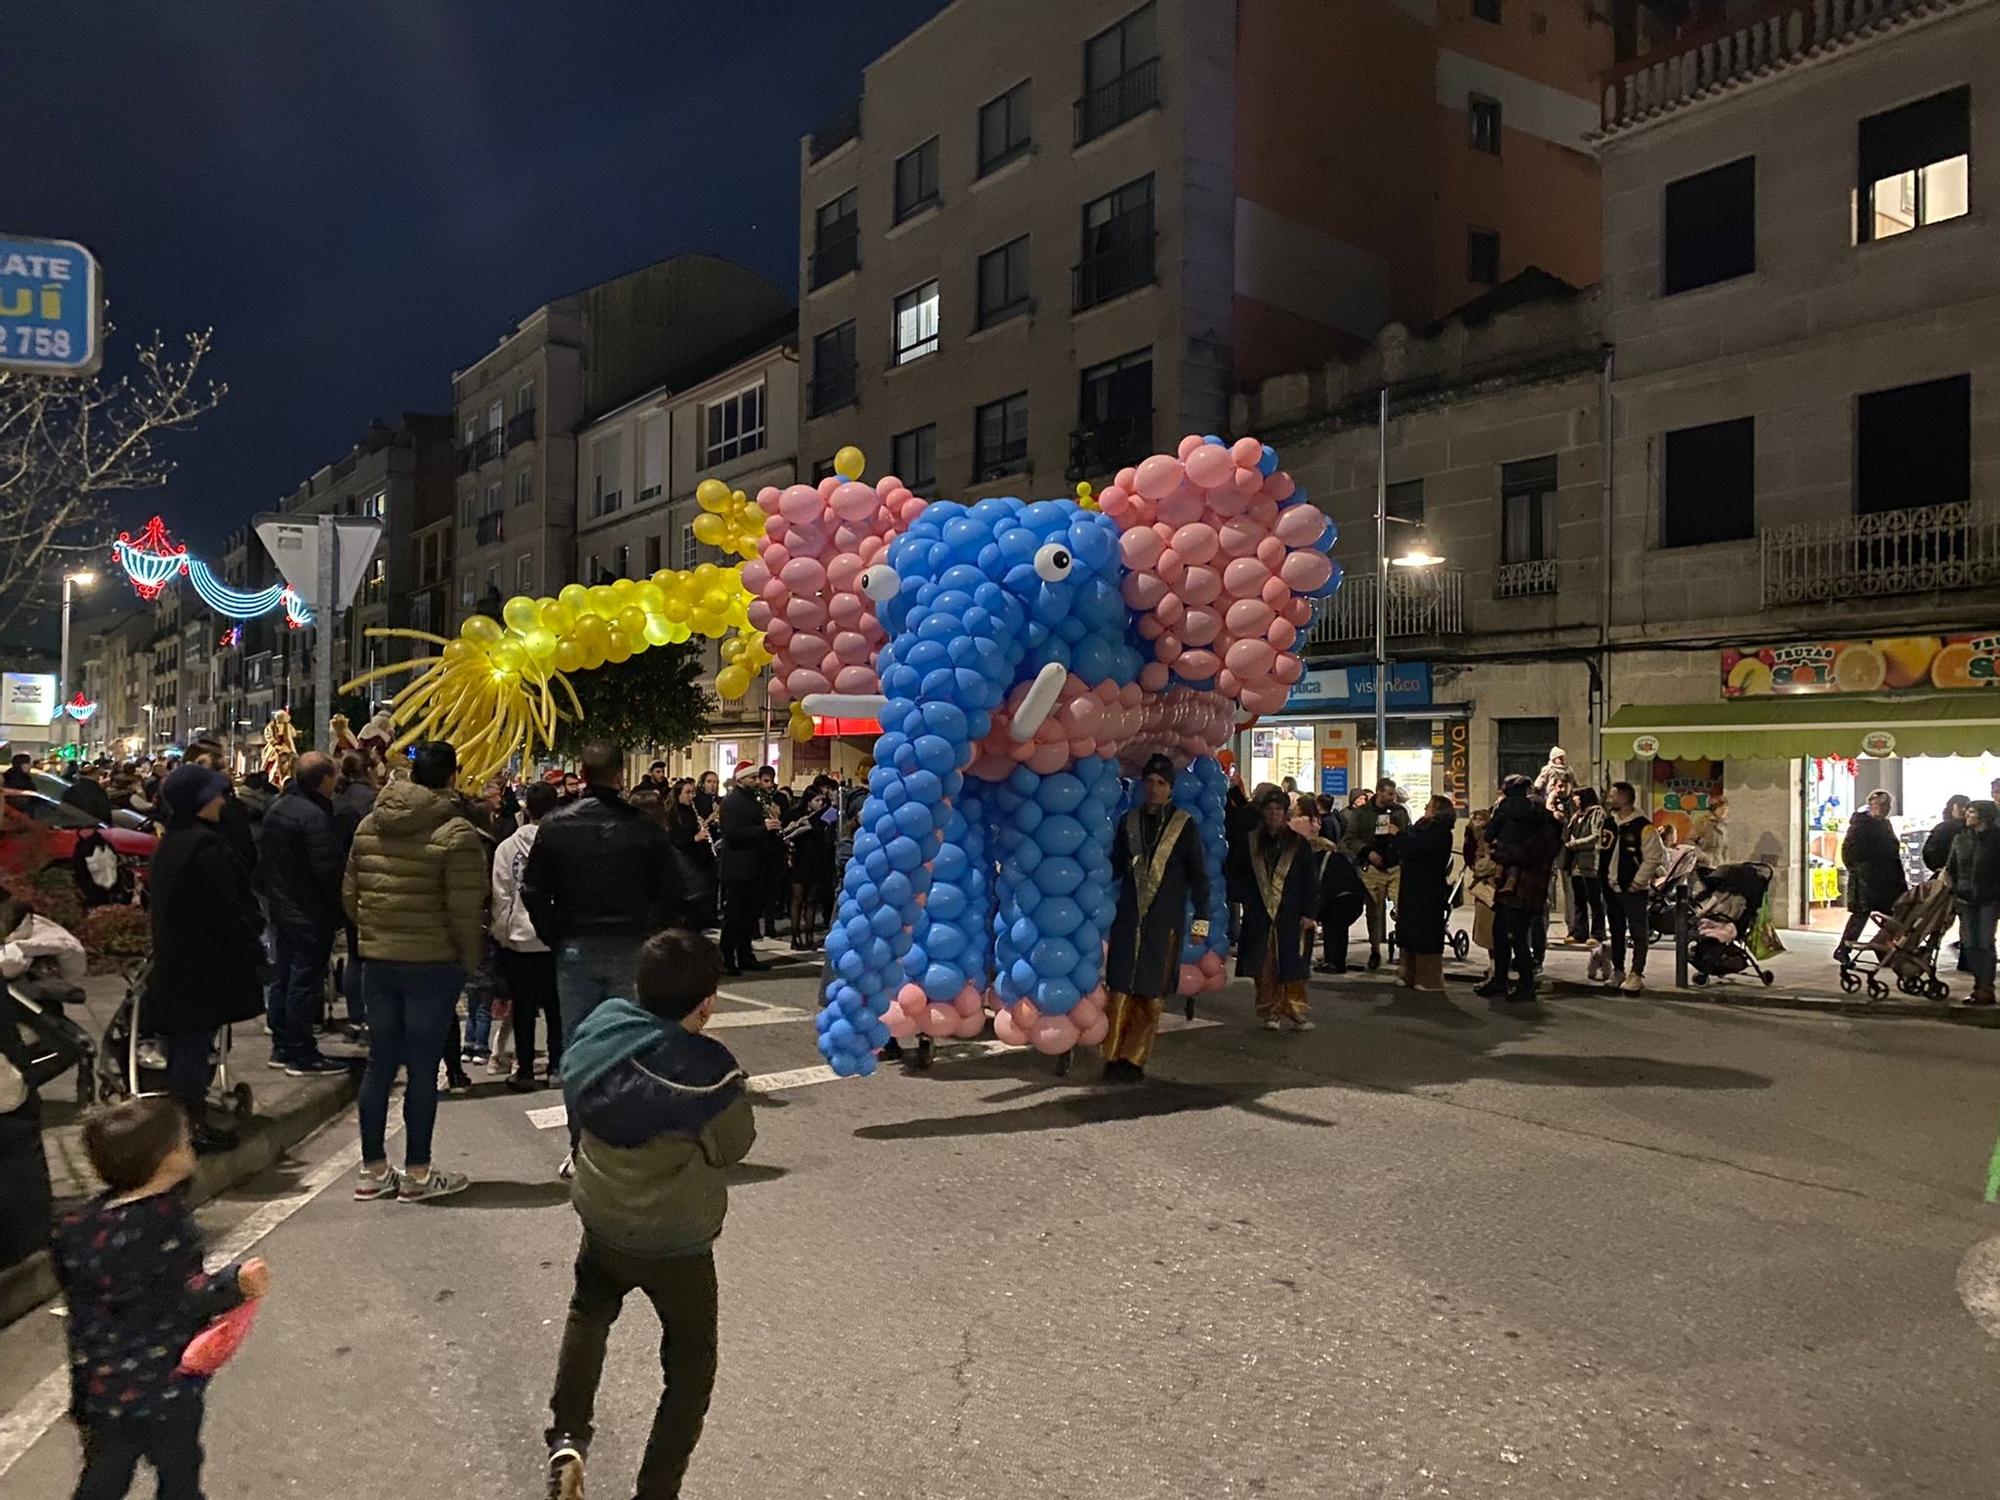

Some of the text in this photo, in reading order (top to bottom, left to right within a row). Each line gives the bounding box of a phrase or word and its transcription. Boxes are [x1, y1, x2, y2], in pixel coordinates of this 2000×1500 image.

[0, 254, 71, 280] ATE
[16, 326, 70, 358] 758
[1774, 647, 1834, 661] FRUTAS
[1354, 677, 1420, 694] visin&co
[434, 1177, 448, 1189] N
